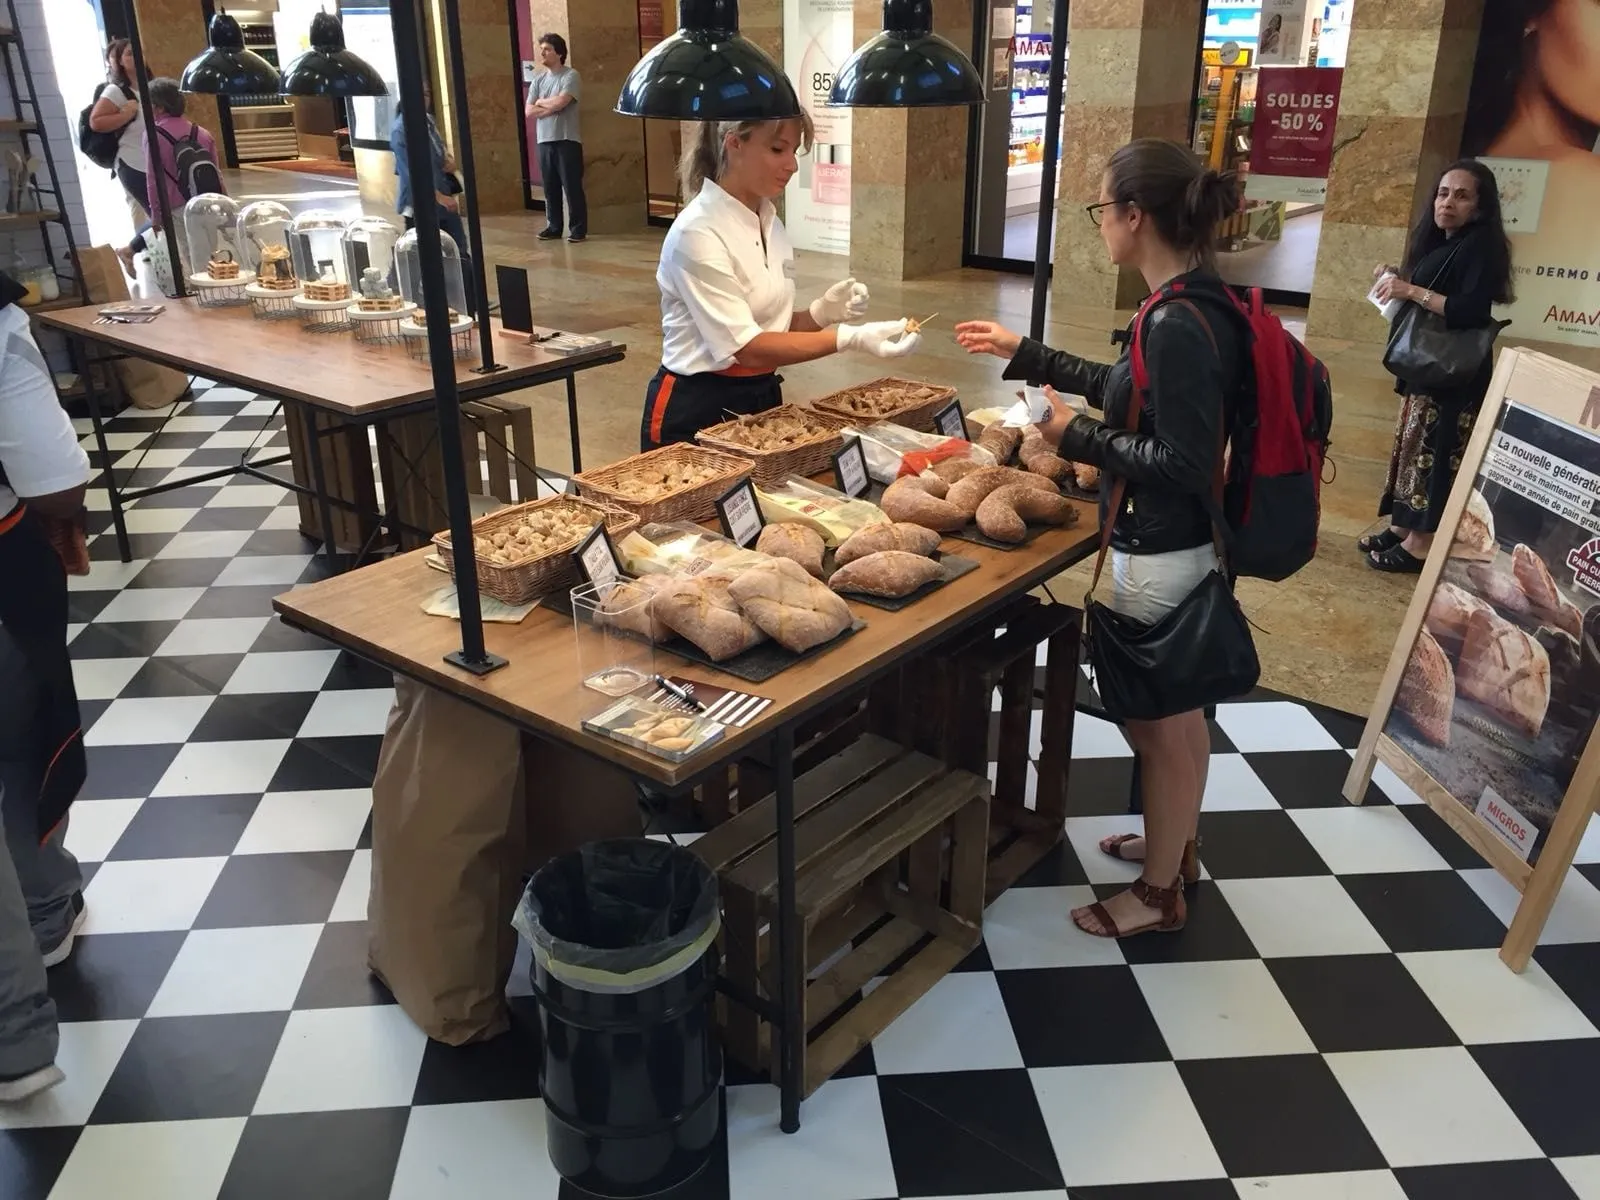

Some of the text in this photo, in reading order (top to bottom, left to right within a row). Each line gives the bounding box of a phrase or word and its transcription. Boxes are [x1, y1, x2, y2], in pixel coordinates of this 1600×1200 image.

[1266, 93, 1334, 109] SOLDES
[1536, 265, 1589, 280] DERMO
[1497, 436, 1510, 451] La
[1511, 445, 1552, 471] nouvelle
[1487, 468, 1512, 486] gagnez
[1512, 481, 1527, 493] une
[1527, 490, 1550, 506] année
[1551, 499, 1561, 511] de
[1561, 507, 1580, 521] pain
[1523, 470, 1537, 482] dès
[1538, 478, 1581, 504] maintenant
[1581, 499, 1591, 509] et
[1572, 556, 1600, 578] PAIN CU
[1487, 800, 1527, 841] MIGROS
